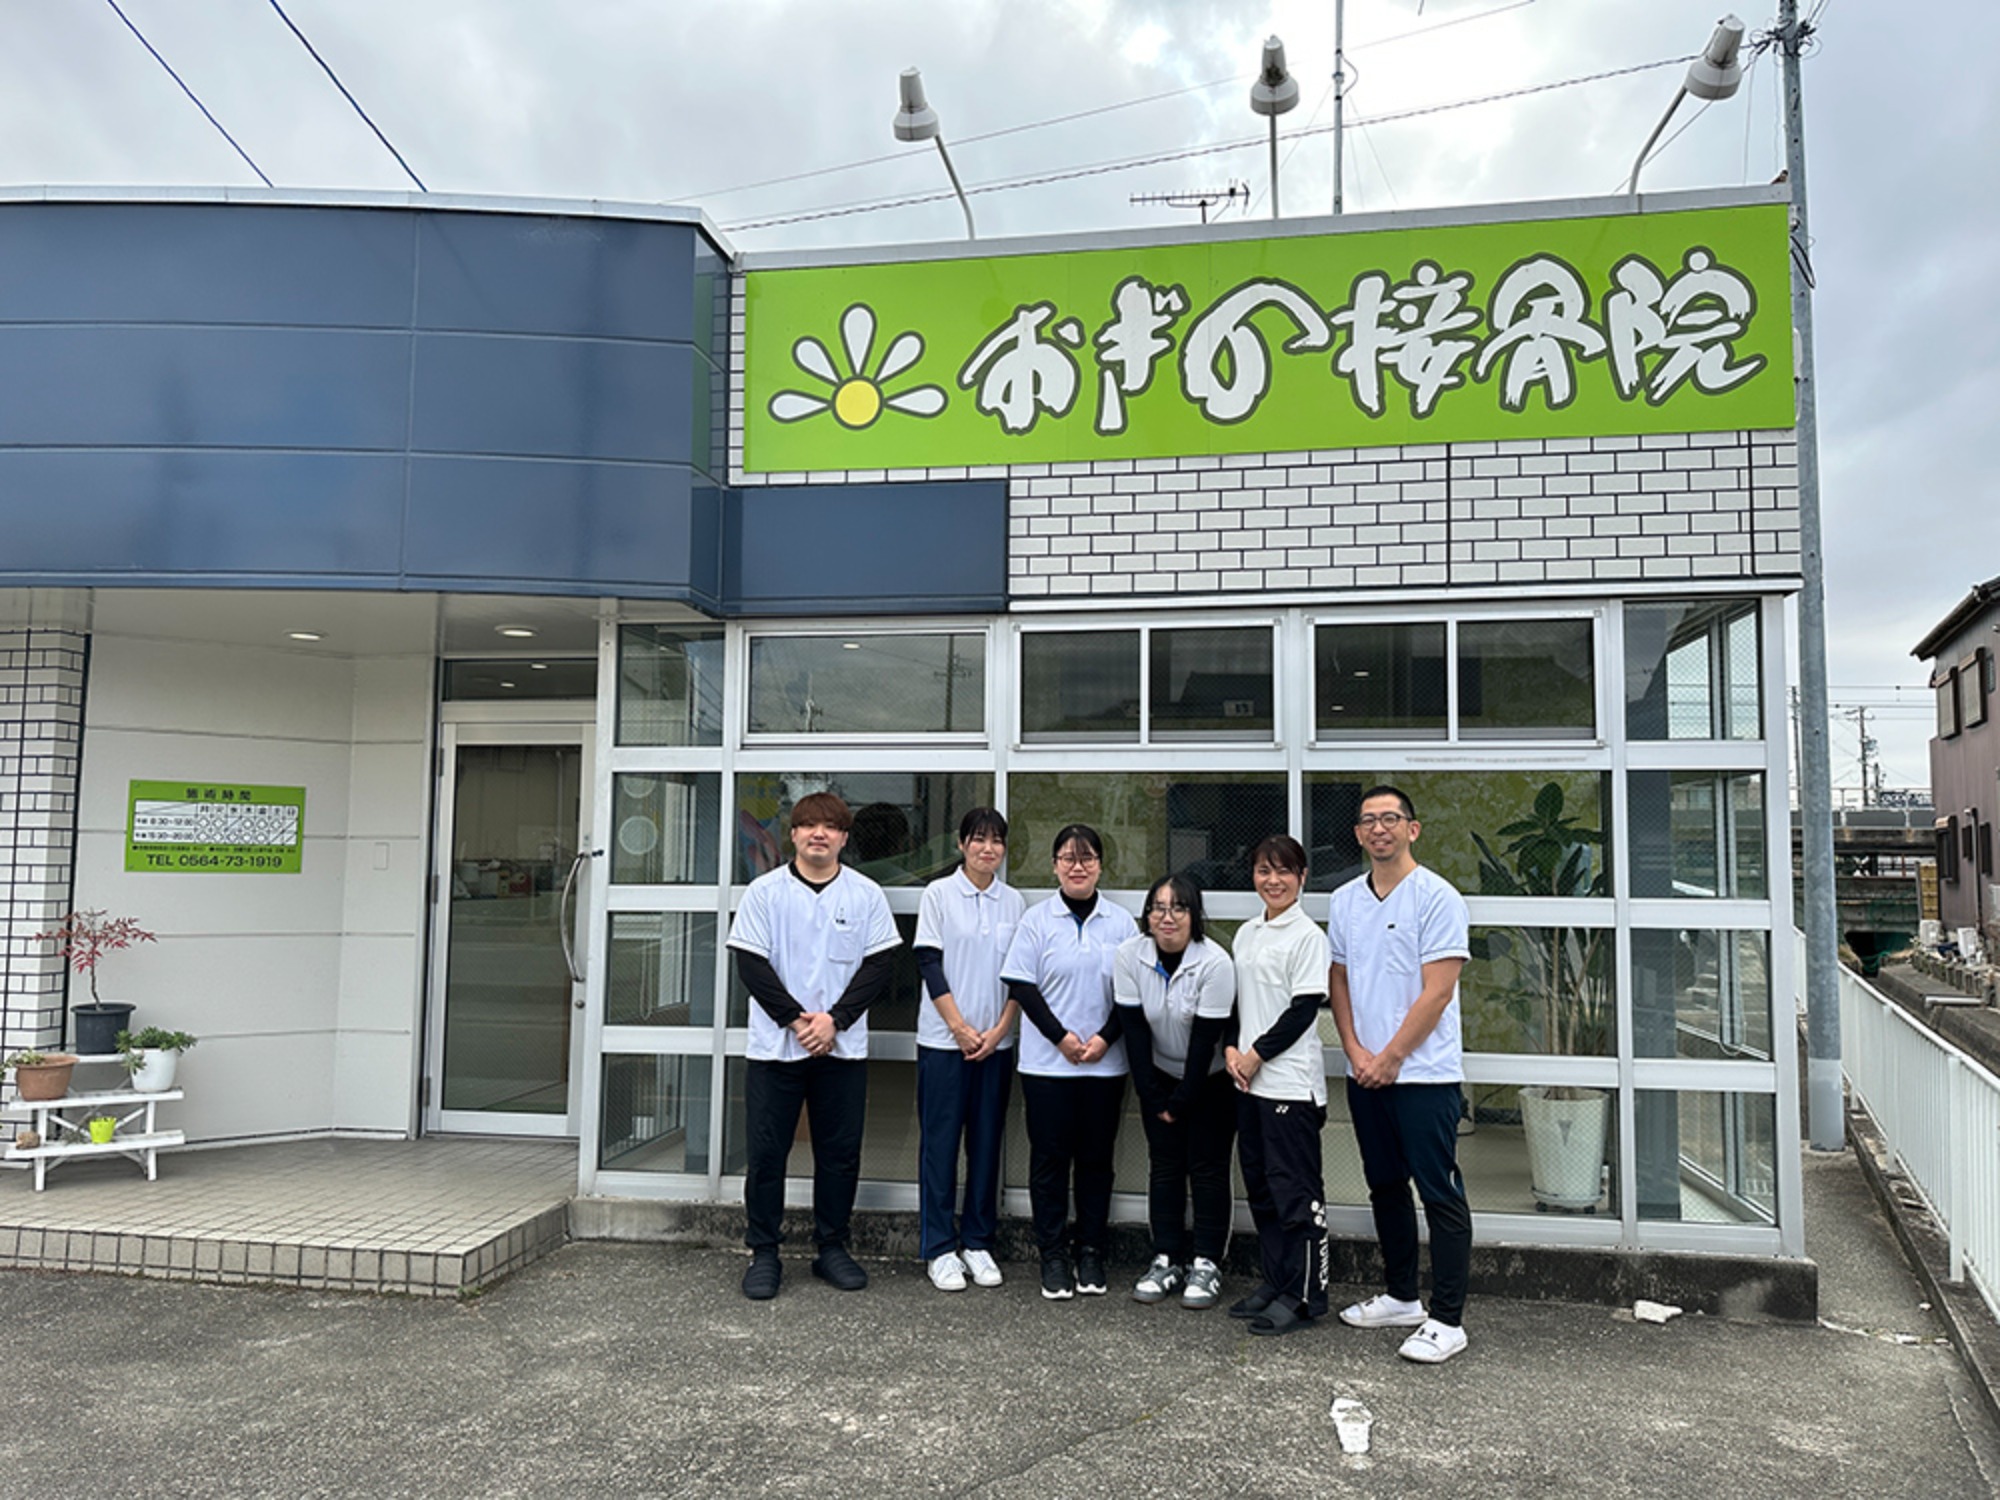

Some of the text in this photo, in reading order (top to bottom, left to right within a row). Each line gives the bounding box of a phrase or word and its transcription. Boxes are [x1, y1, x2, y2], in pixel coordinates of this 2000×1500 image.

[960, 246, 1765, 435] おぎの接骨院
[146, 853, 282, 868] TEL 0564-73-1919
